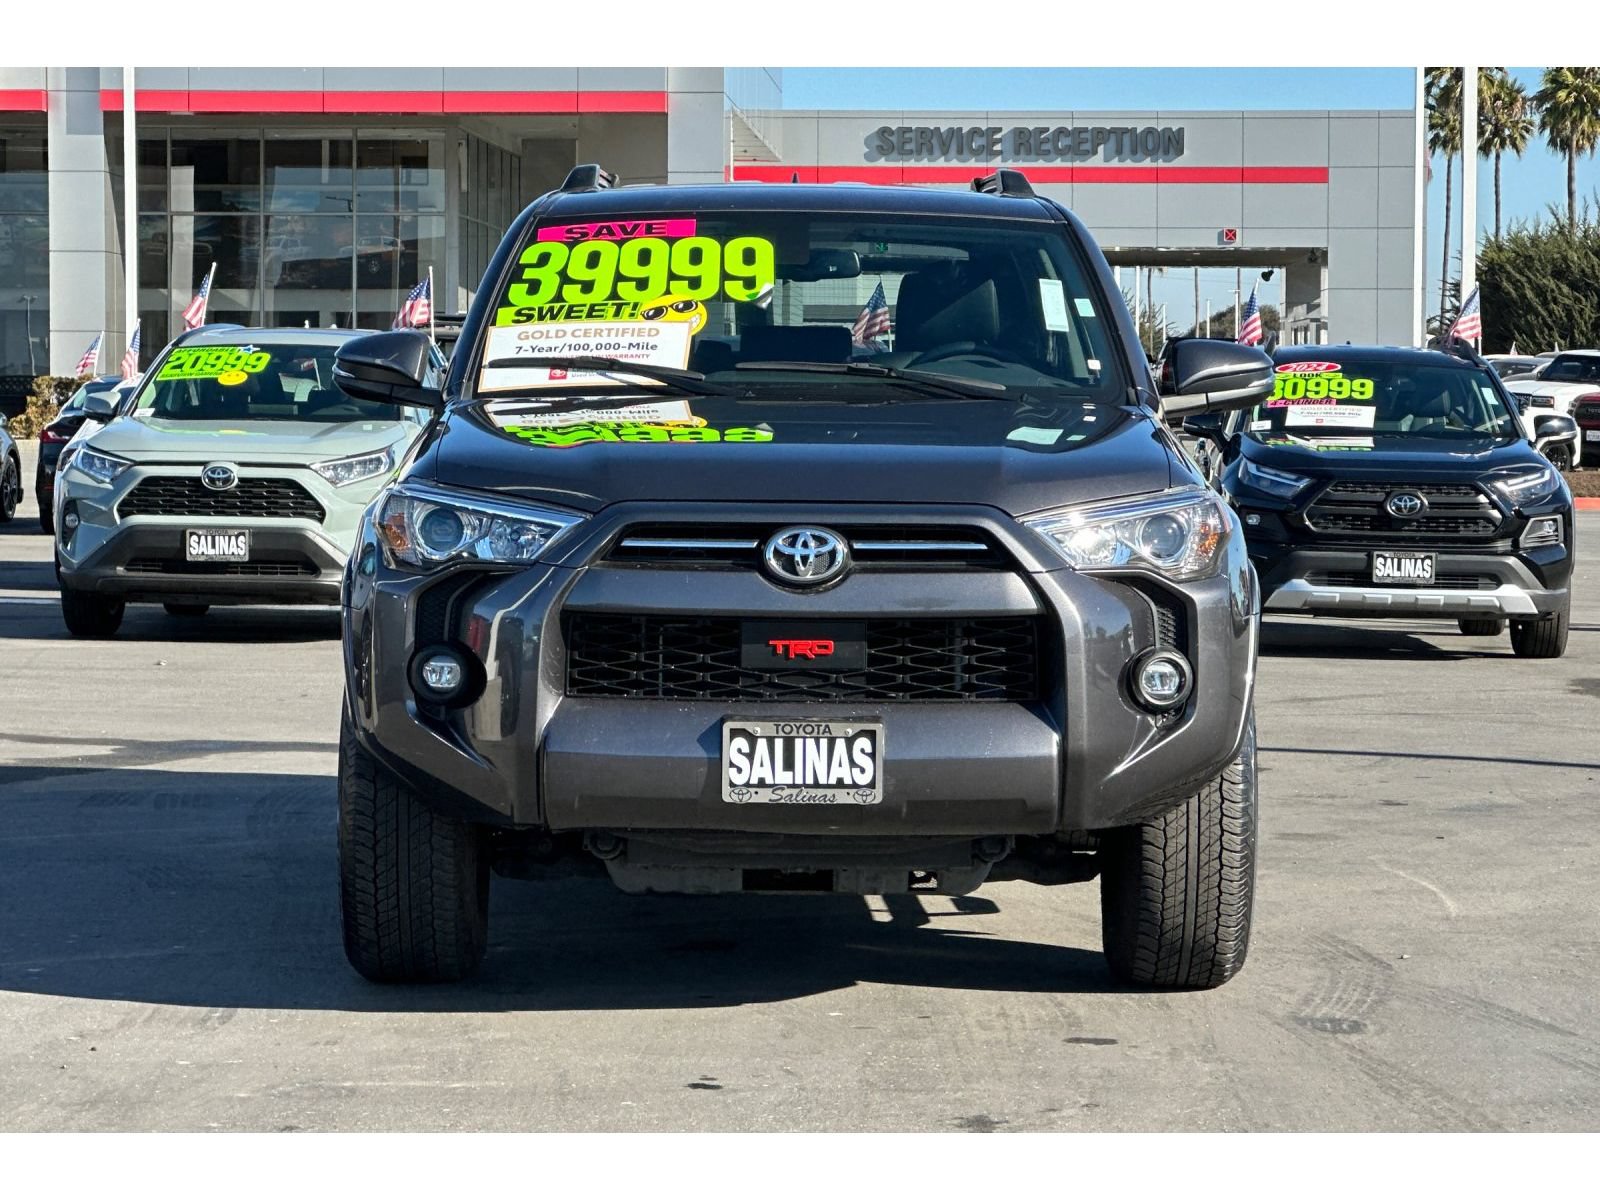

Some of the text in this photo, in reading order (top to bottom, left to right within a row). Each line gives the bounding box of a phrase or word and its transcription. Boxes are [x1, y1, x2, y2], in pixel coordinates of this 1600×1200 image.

[875, 126, 1185, 157] SERVICE RECEPTION
[564, 222, 668, 241] SAVE
[508, 236, 776, 306] 39999
[511, 301, 642, 325] SWEET!
[517, 327, 660, 342] GOLD CERTIFIED
[515, 341, 658, 355] 7-Year/100,000-Mile
[159, 351, 271, 373] 20999
[1286, 362, 1328, 372] 2024
[190, 534, 246, 556] SALINAS
[1375, 557, 1432, 578] SALINAS
[768, 639, 835, 659] TRD
[773, 723, 833, 736] TOYOTA
[728, 736, 874, 786] SALINAS
[768, 785, 838, 804] Salinas
